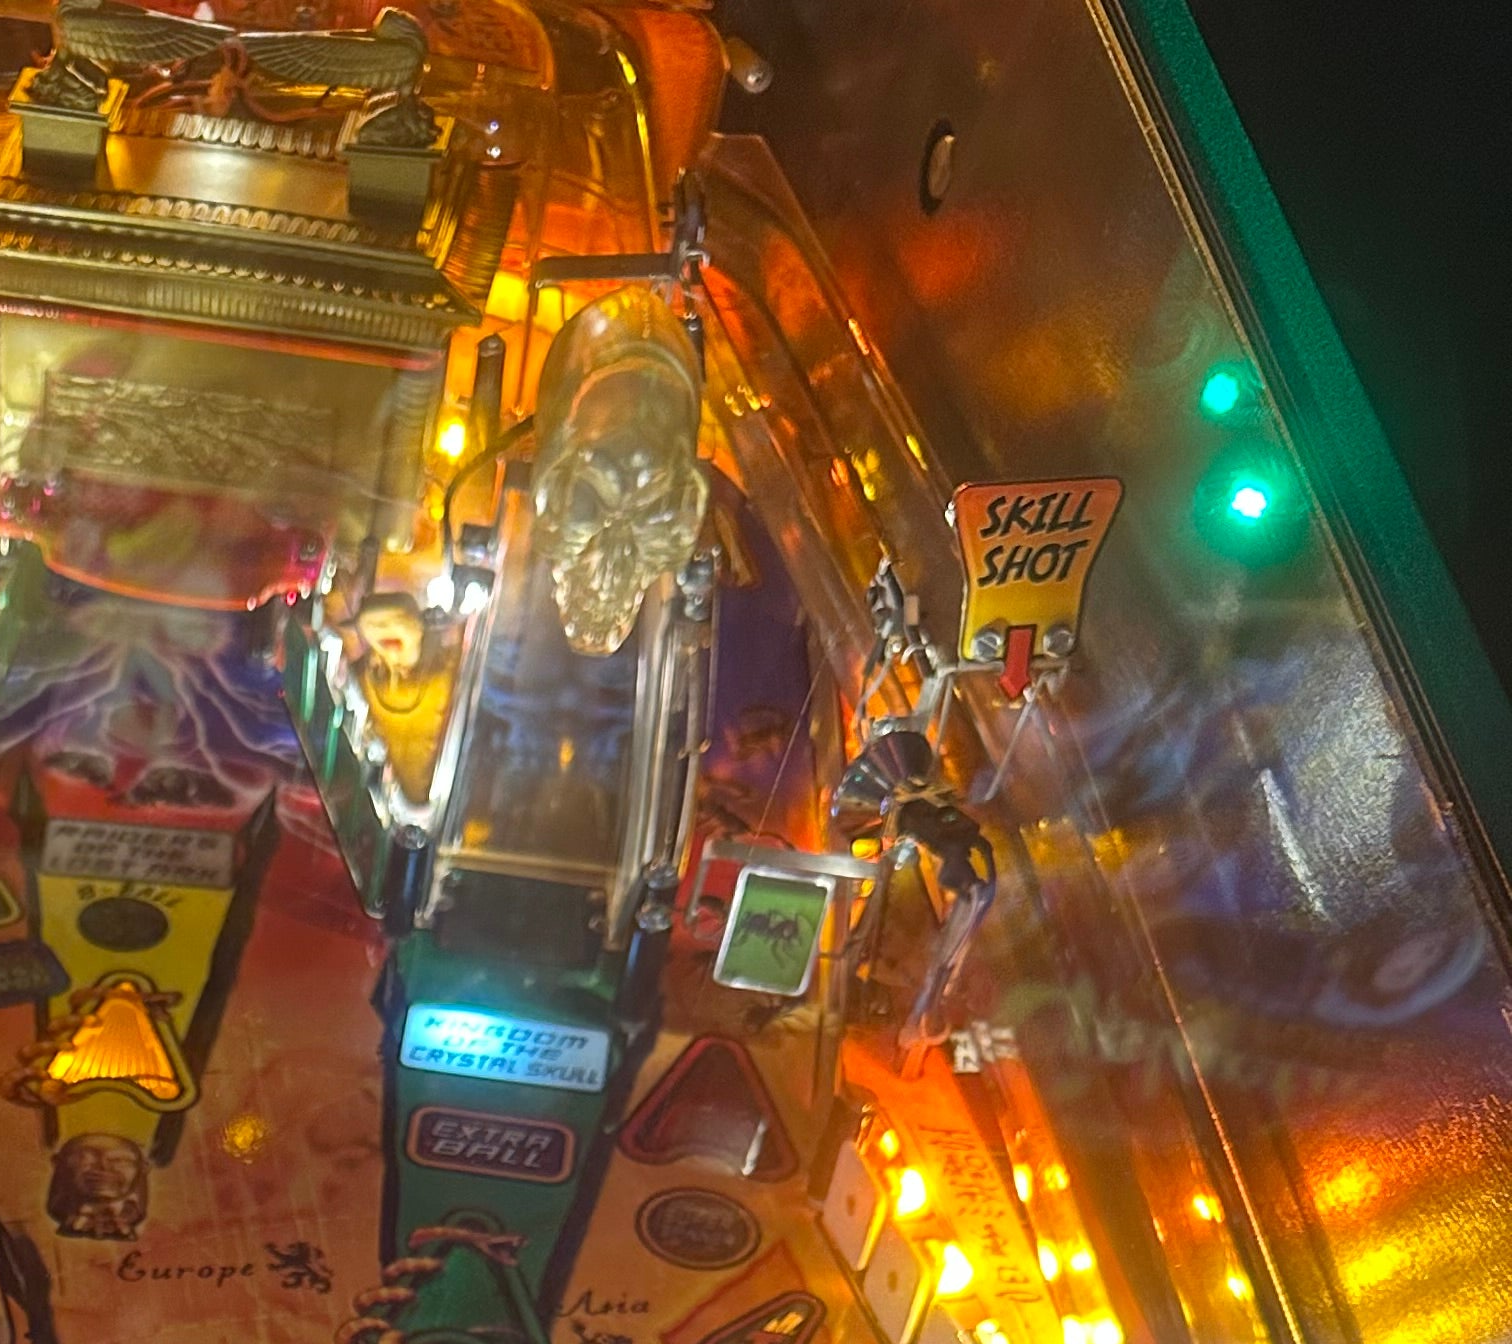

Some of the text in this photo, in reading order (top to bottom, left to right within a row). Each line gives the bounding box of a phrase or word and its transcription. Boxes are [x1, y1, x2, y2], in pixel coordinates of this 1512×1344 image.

[979, 490, 1095, 540] SKILL
[977, 536, 1089, 588] SHOT
[423, 1015, 588, 1050] KINGDOM
[408, 1046, 600, 1085] CRYSTAL SKULL
[501, 1042, 563, 1062] THE
[431, 1118, 553, 1150] EXTRA
[432, 1139, 544, 1169] BALL
[116, 1248, 256, 1286] Europe
[557, 1289, 650, 1318] Asia
